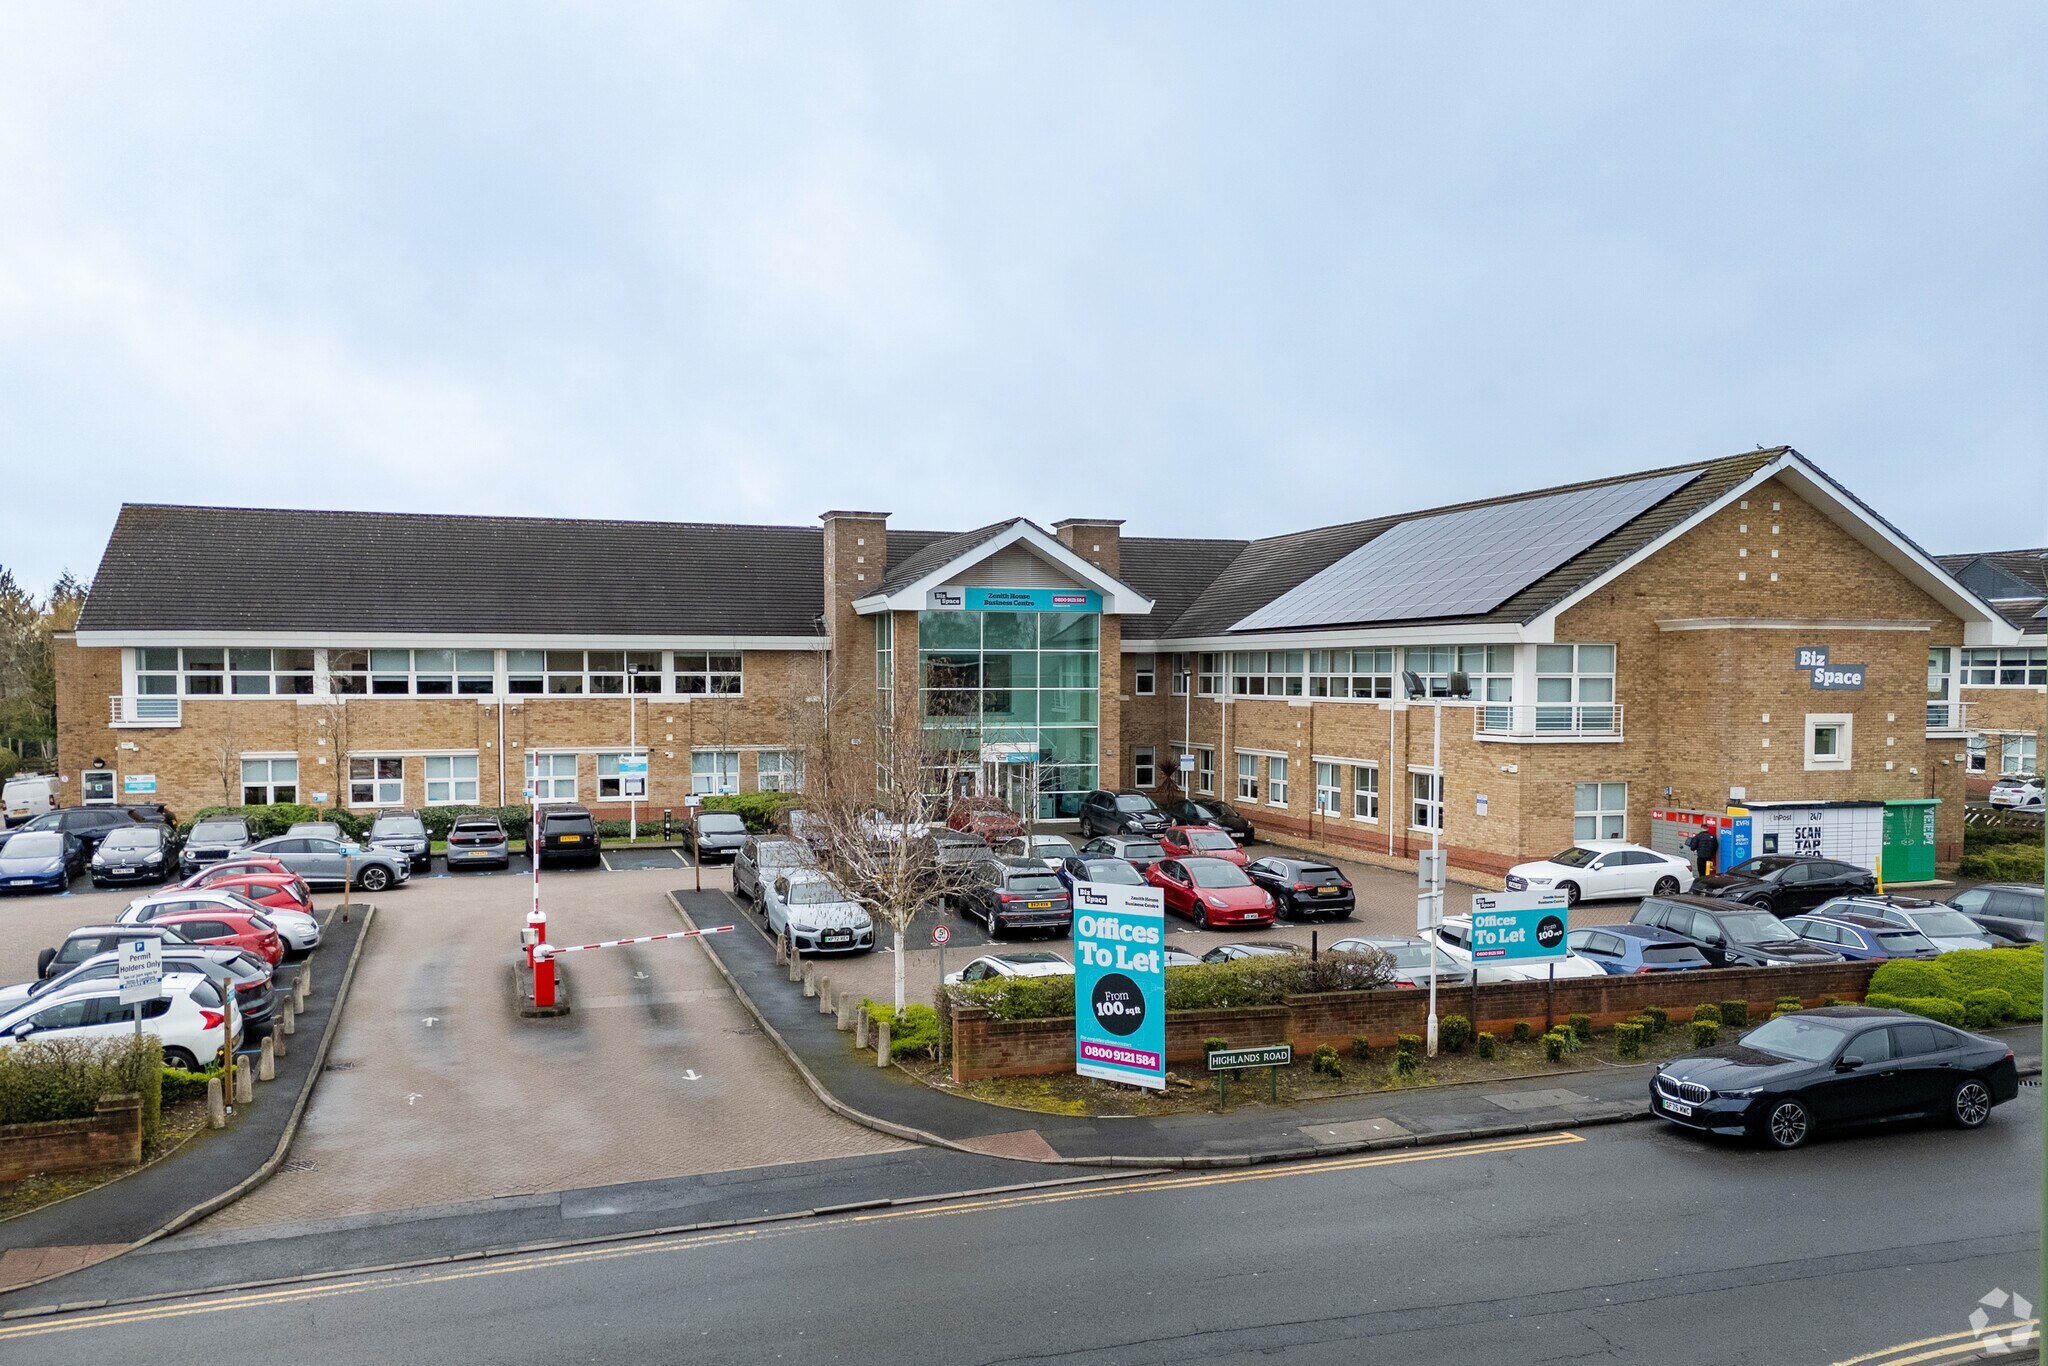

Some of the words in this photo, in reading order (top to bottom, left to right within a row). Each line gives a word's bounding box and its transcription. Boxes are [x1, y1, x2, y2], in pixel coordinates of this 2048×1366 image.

[1800, 650, 1826, 666] Biz
[1814, 668, 1862, 687] Space
[1810, 811, 1822, 821] 24/7
[1795, 826, 1821, 840] SCAN
[1794, 840, 1821, 850] TAP
[1080, 888, 1091, 896] Biz
[1086, 895, 1107, 904] Space
[1475, 915, 1517, 927] Offices
[1078, 915, 1159, 944] Offices
[1474, 929, 1496, 945] To
[1498, 927, 1525, 944] Let
[1538, 930, 1553, 941] 100
[129, 952, 151, 961] Permit
[1078, 941, 1113, 967] To
[1115, 944, 1160, 973] Let
[120, 962, 145, 973] Holders
[146, 960, 161, 968] Only
[1105, 991, 1129, 1001] From
[1096, 1001, 1124, 1016] 100
[1084, 1045, 1113, 1059] 0800
[1113, 1050, 1136, 1064] 9121
[1136, 1053, 1156, 1067] 584
[1212, 1053, 1260, 1066] HIGHLANDS
[1263, 1051, 1287, 1061] ROAD
